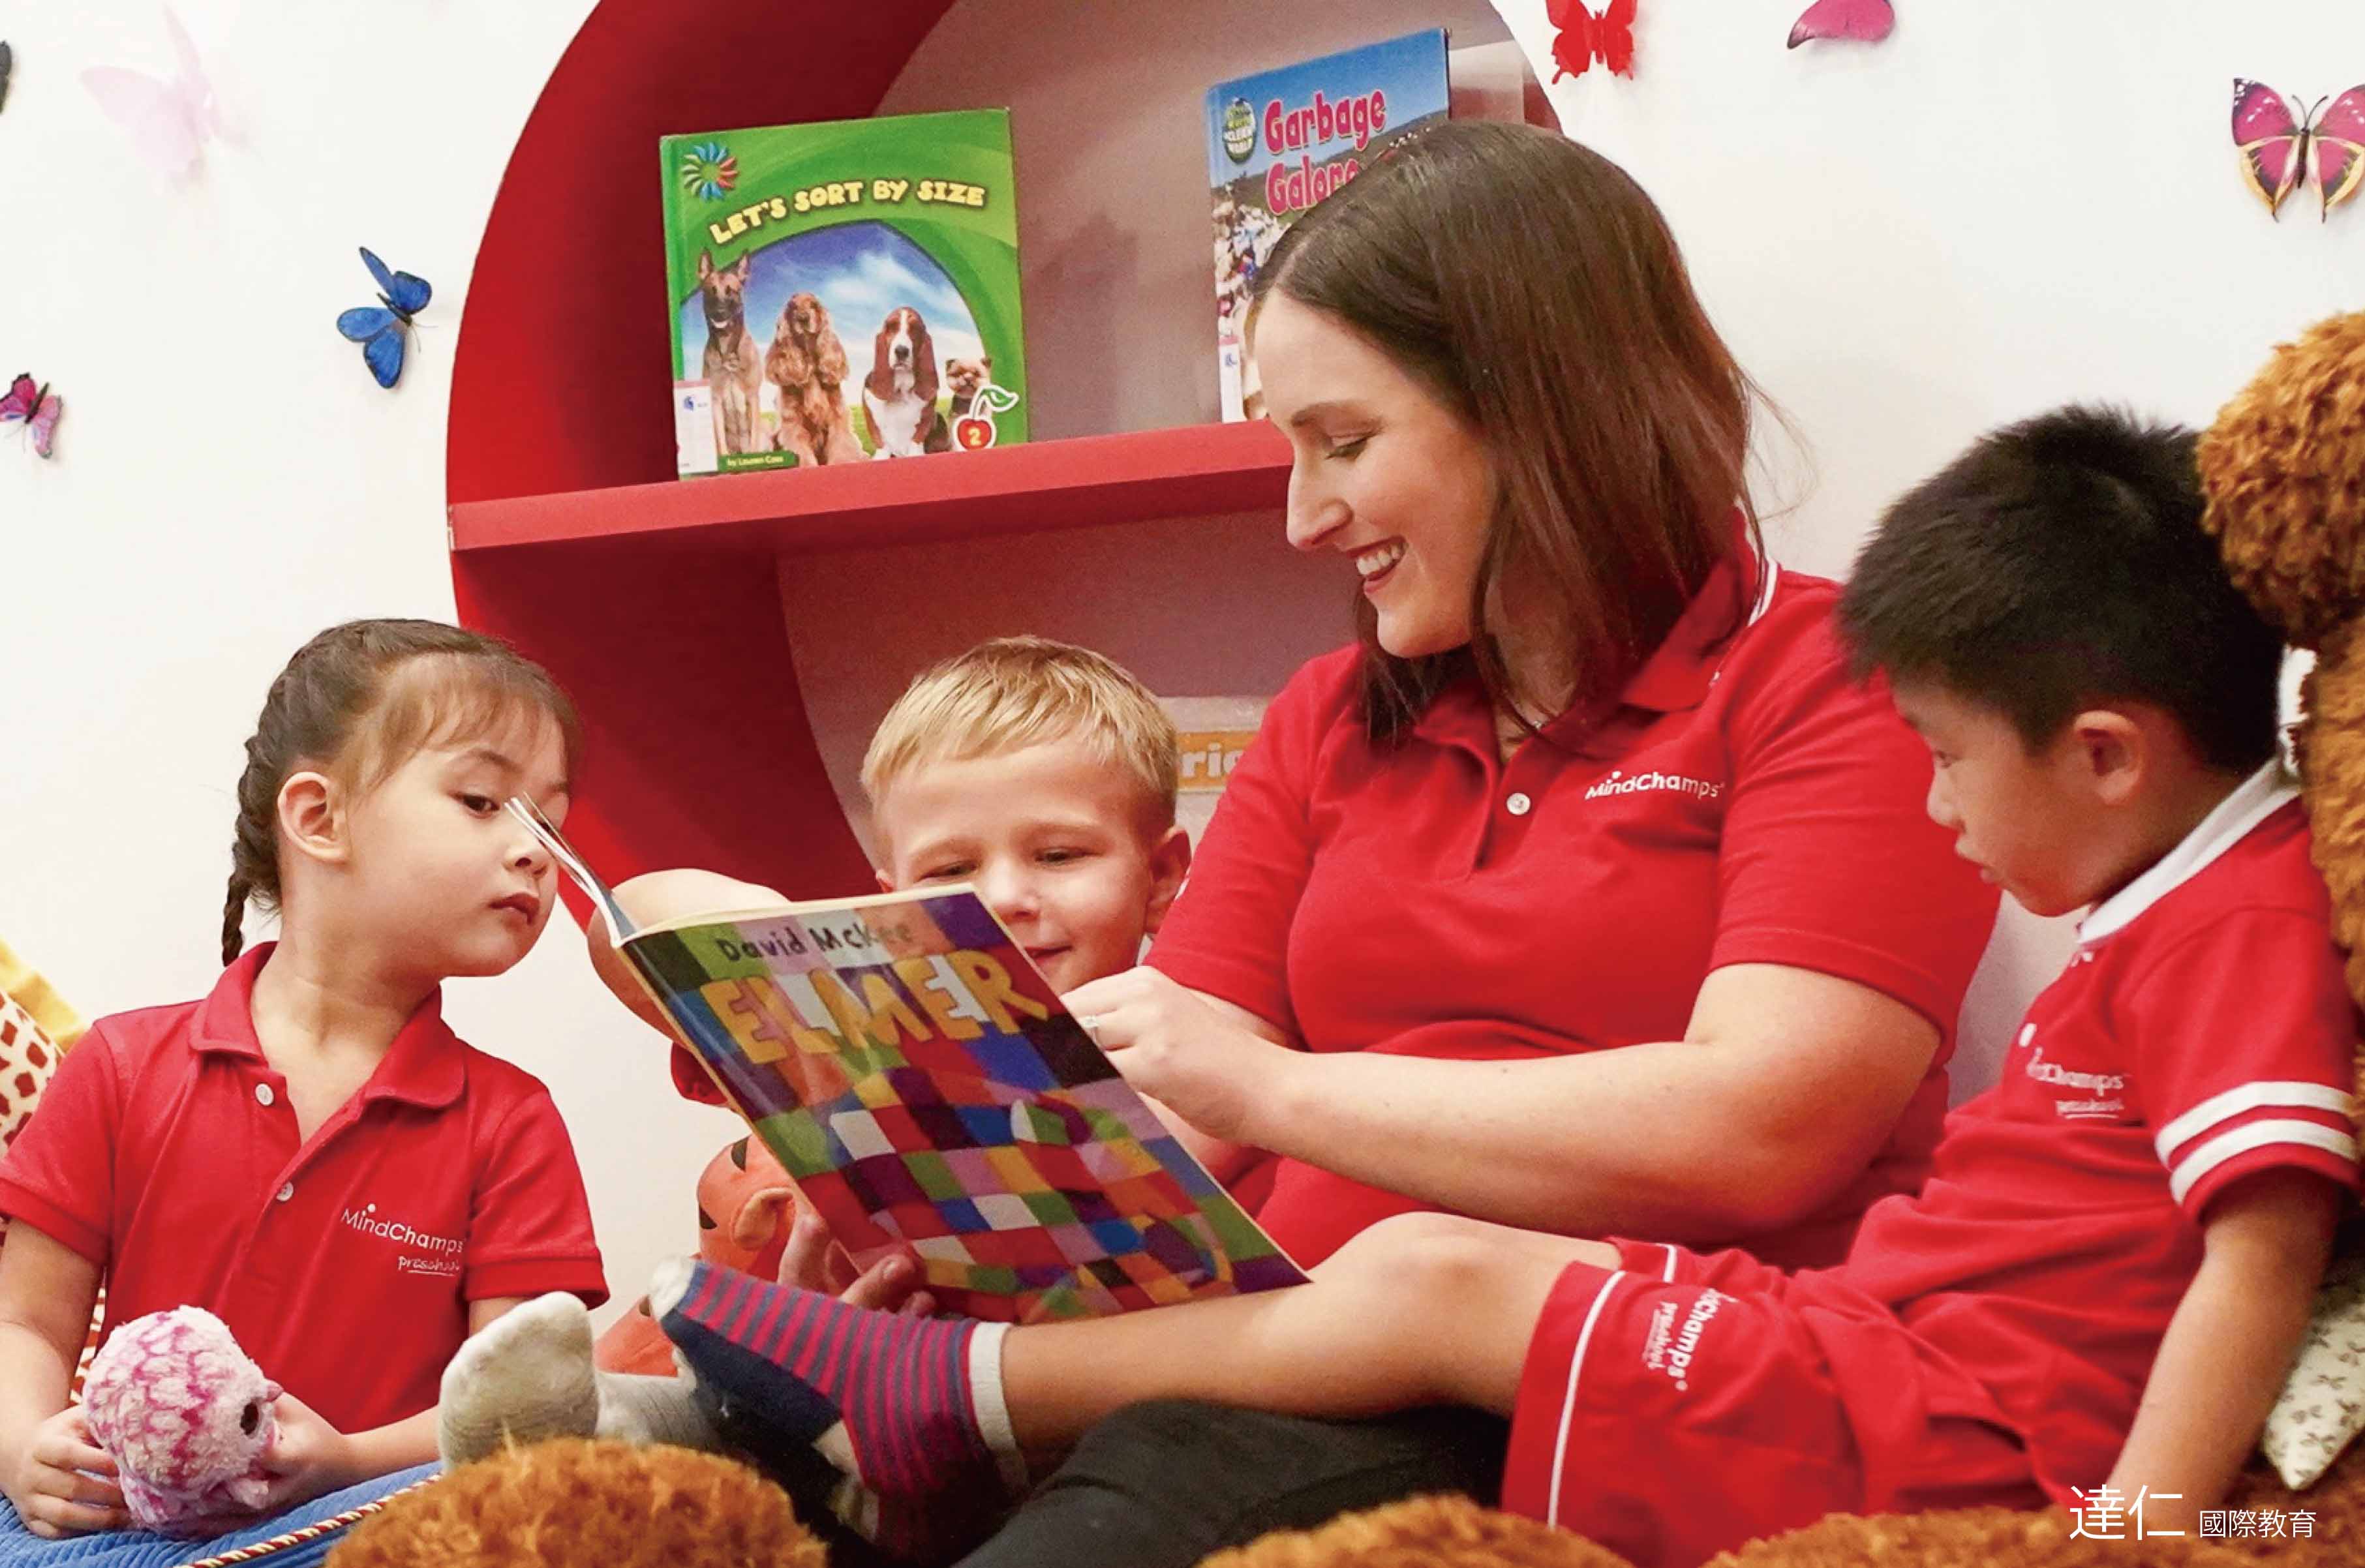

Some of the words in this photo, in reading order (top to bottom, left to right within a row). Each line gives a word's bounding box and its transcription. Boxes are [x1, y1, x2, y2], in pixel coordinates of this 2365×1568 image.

[1264, 89, 1386, 155] Garbage
[709, 196, 788, 245] LET'S
[793, 181, 864, 212] SORT
[872, 179, 910, 202] BY
[917, 180, 986, 207] SIZE
[967, 427, 983, 446] 2
[1584, 771, 1718, 800] MindChamps
[716, 926, 808, 962] David
[700, 948, 1048, 1065] ELMER
[341, 1203, 464, 1257] MindChamps
